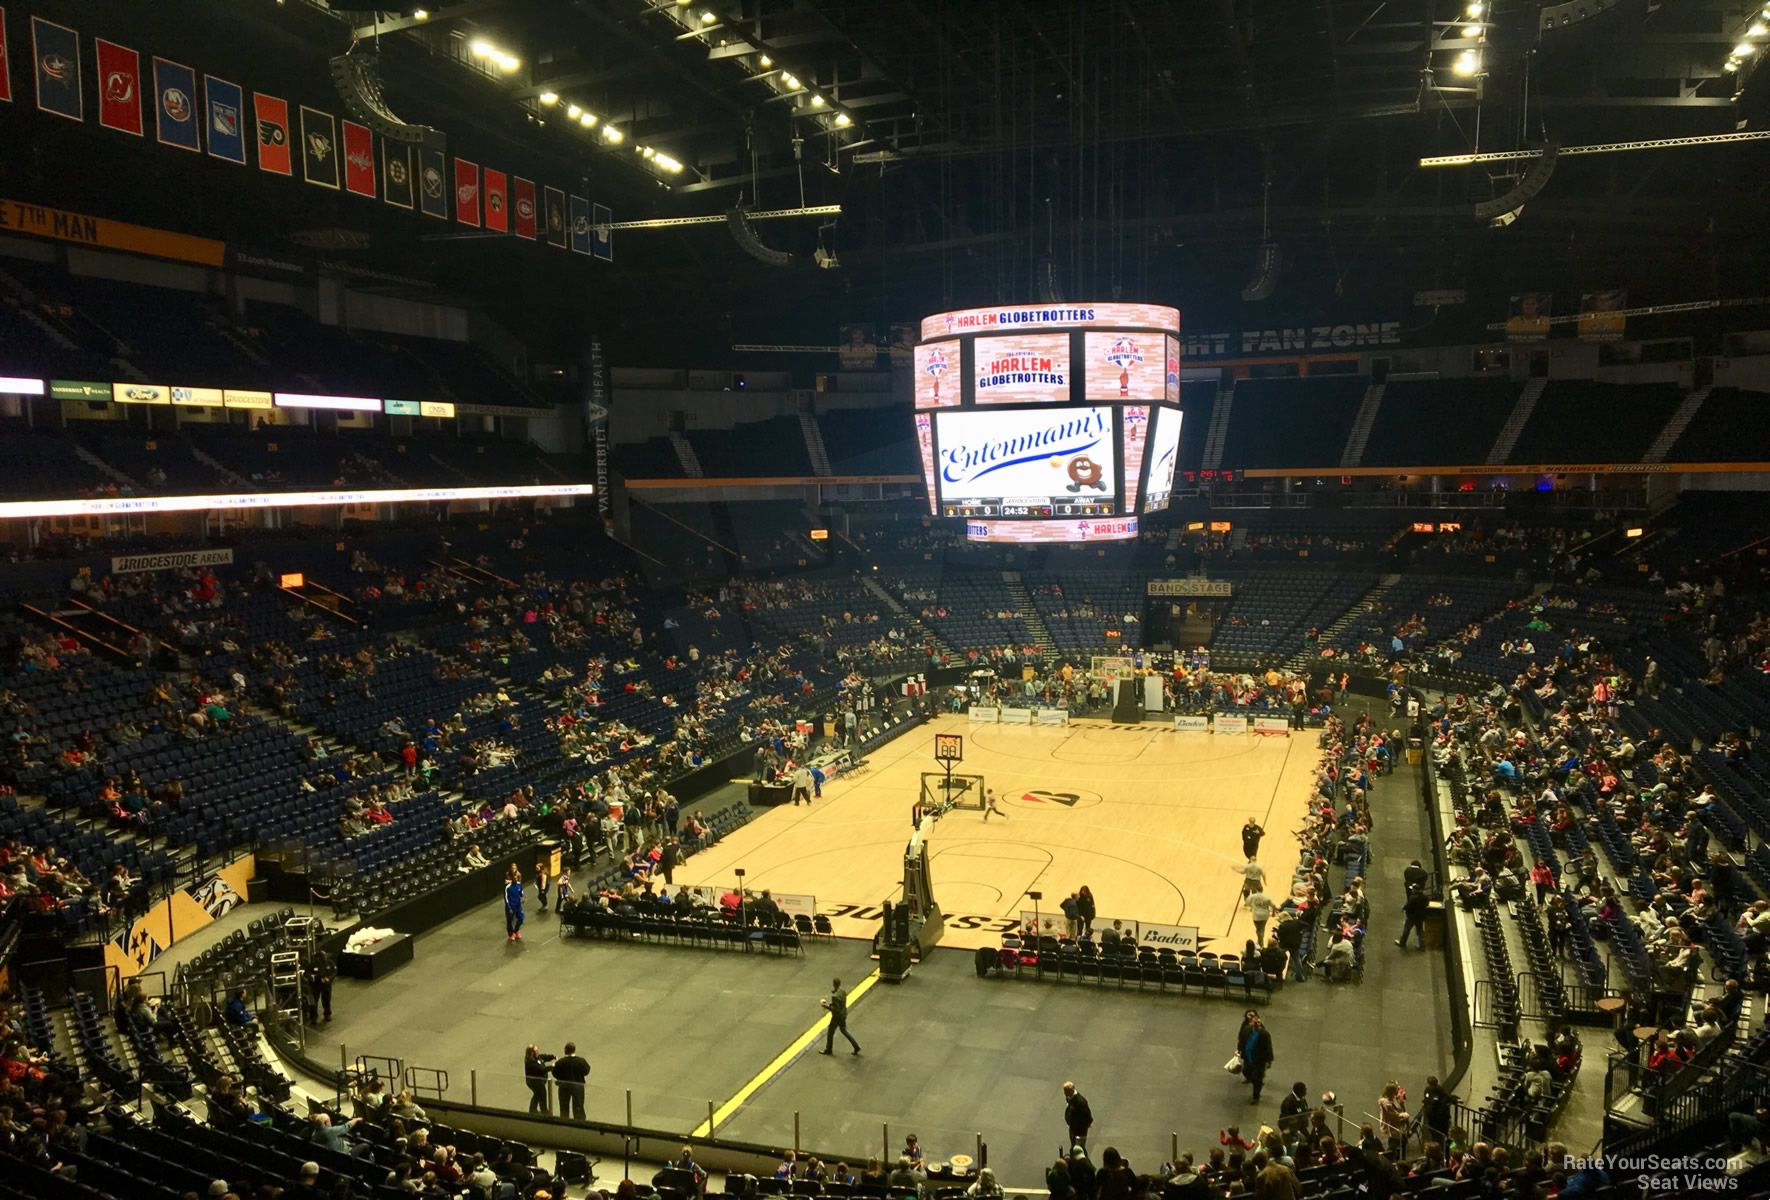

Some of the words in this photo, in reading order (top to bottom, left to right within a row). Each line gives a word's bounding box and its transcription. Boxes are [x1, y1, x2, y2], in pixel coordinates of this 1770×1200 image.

[14, 203, 47, 228] 7TH
[53, 212, 98, 242] MAN
[957, 313, 997, 328] HARLEM
[999, 309, 1095, 324] GLOBETROTTERS
[1242, 328, 1305, 352] FAN
[1311, 321, 1400, 348] ZONE
[592, 342, 603, 399] HEALTH
[991, 357, 1051, 374] HARLEM
[130, 390, 154, 400] Ford
[942, 407, 1110, 482] Entenmann's
[596, 427, 609, 512] VANDERBILT
[984, 506, 991, 514] 0
[1004, 507, 1029, 515] 24:52
[1065, 505, 1072, 513] 0
[1095, 524, 1126, 534] HARLEM
[118, 557, 197, 570] BRIDGESTONE
[200, 551, 230, 564] ARENA
[1192, 583, 1230, 593] STAGE
[1177, 720, 1205, 728] Baden
[1143, 930, 1192, 946] Baden
